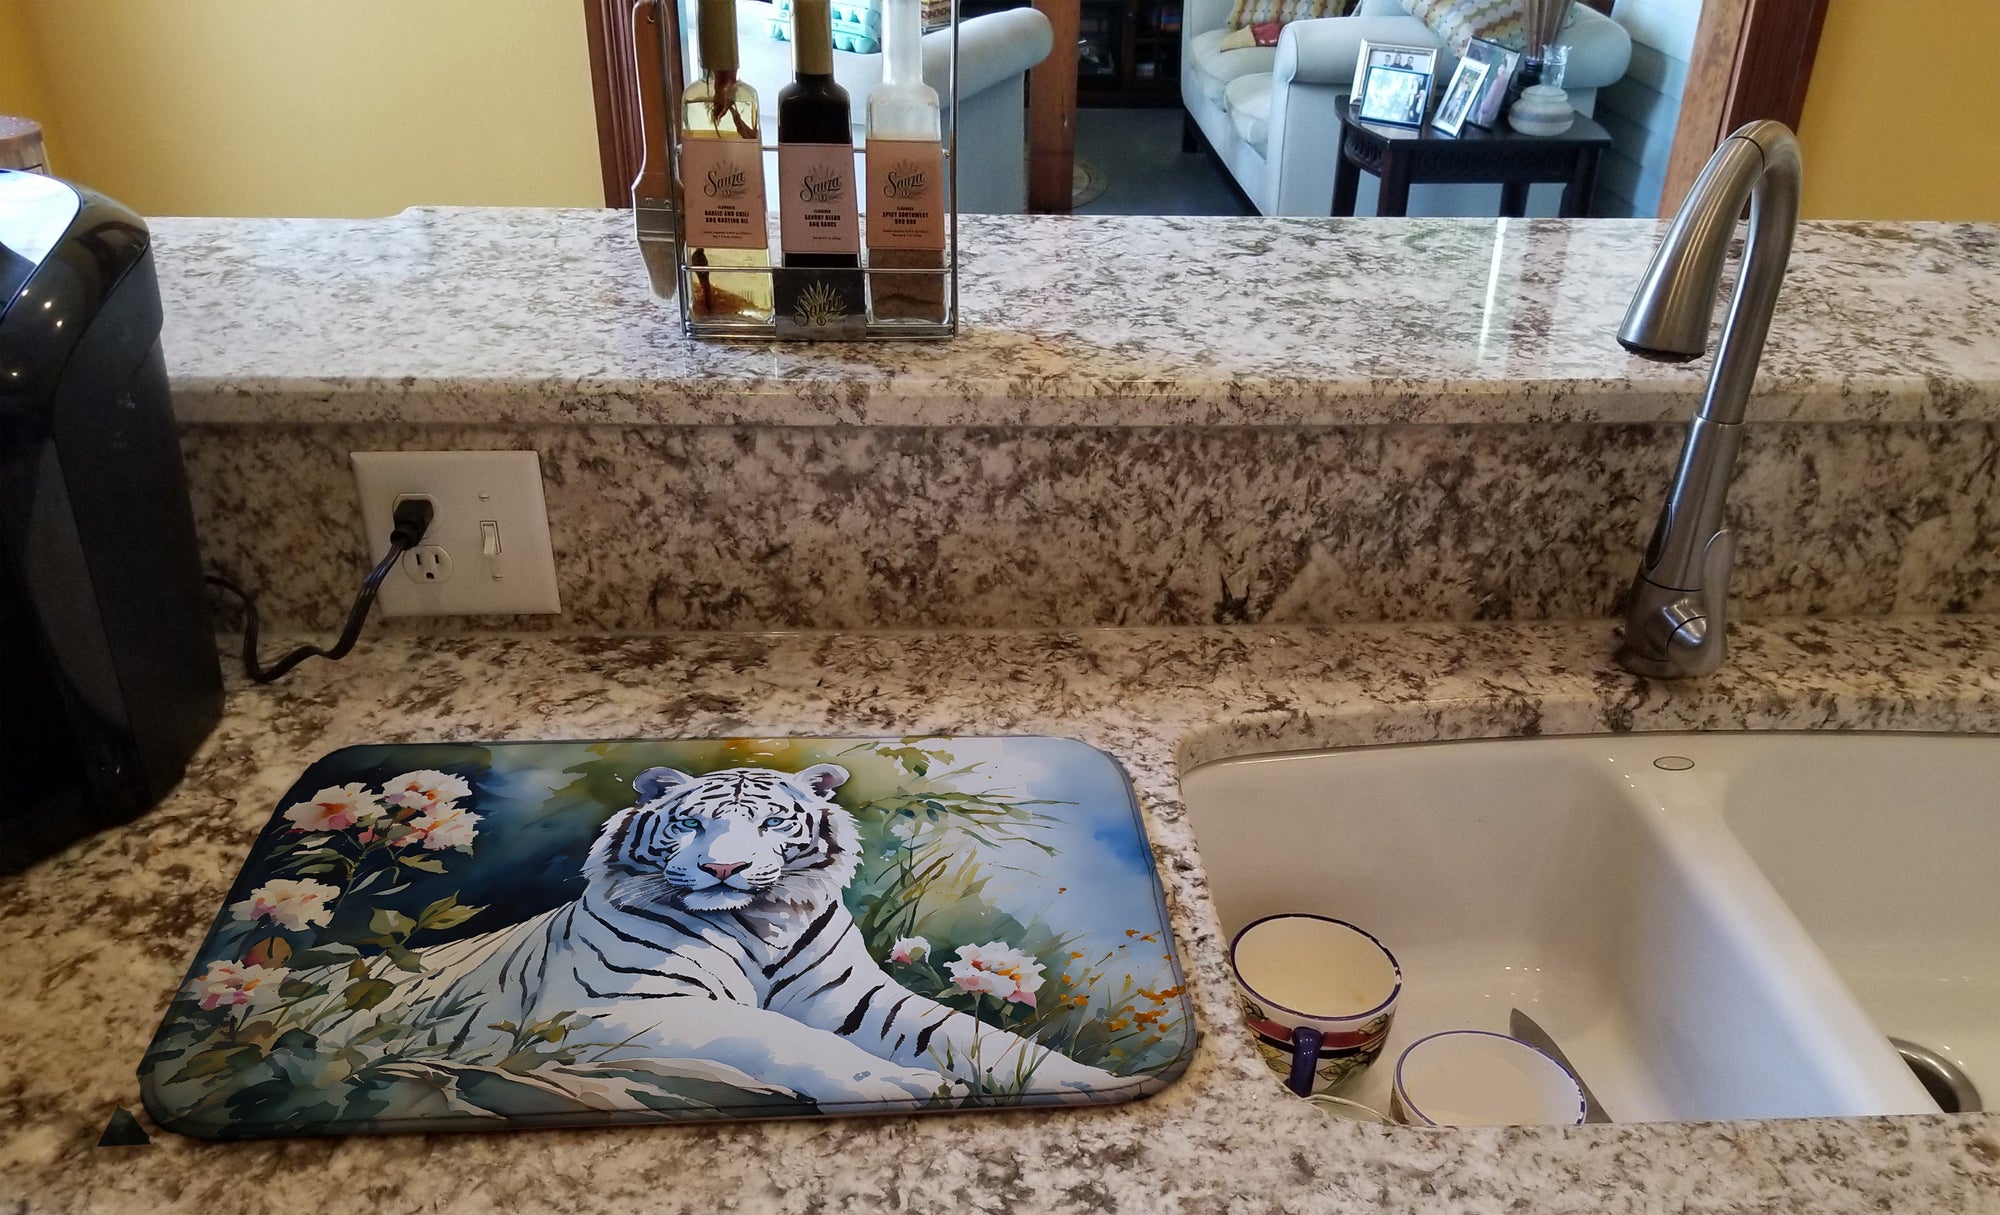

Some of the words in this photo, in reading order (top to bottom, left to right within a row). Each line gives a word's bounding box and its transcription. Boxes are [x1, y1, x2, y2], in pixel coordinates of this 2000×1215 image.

[704, 169, 746, 197] Sauza
[800, 175, 842, 202] Sauza
[884, 170, 926, 198] Sauza
